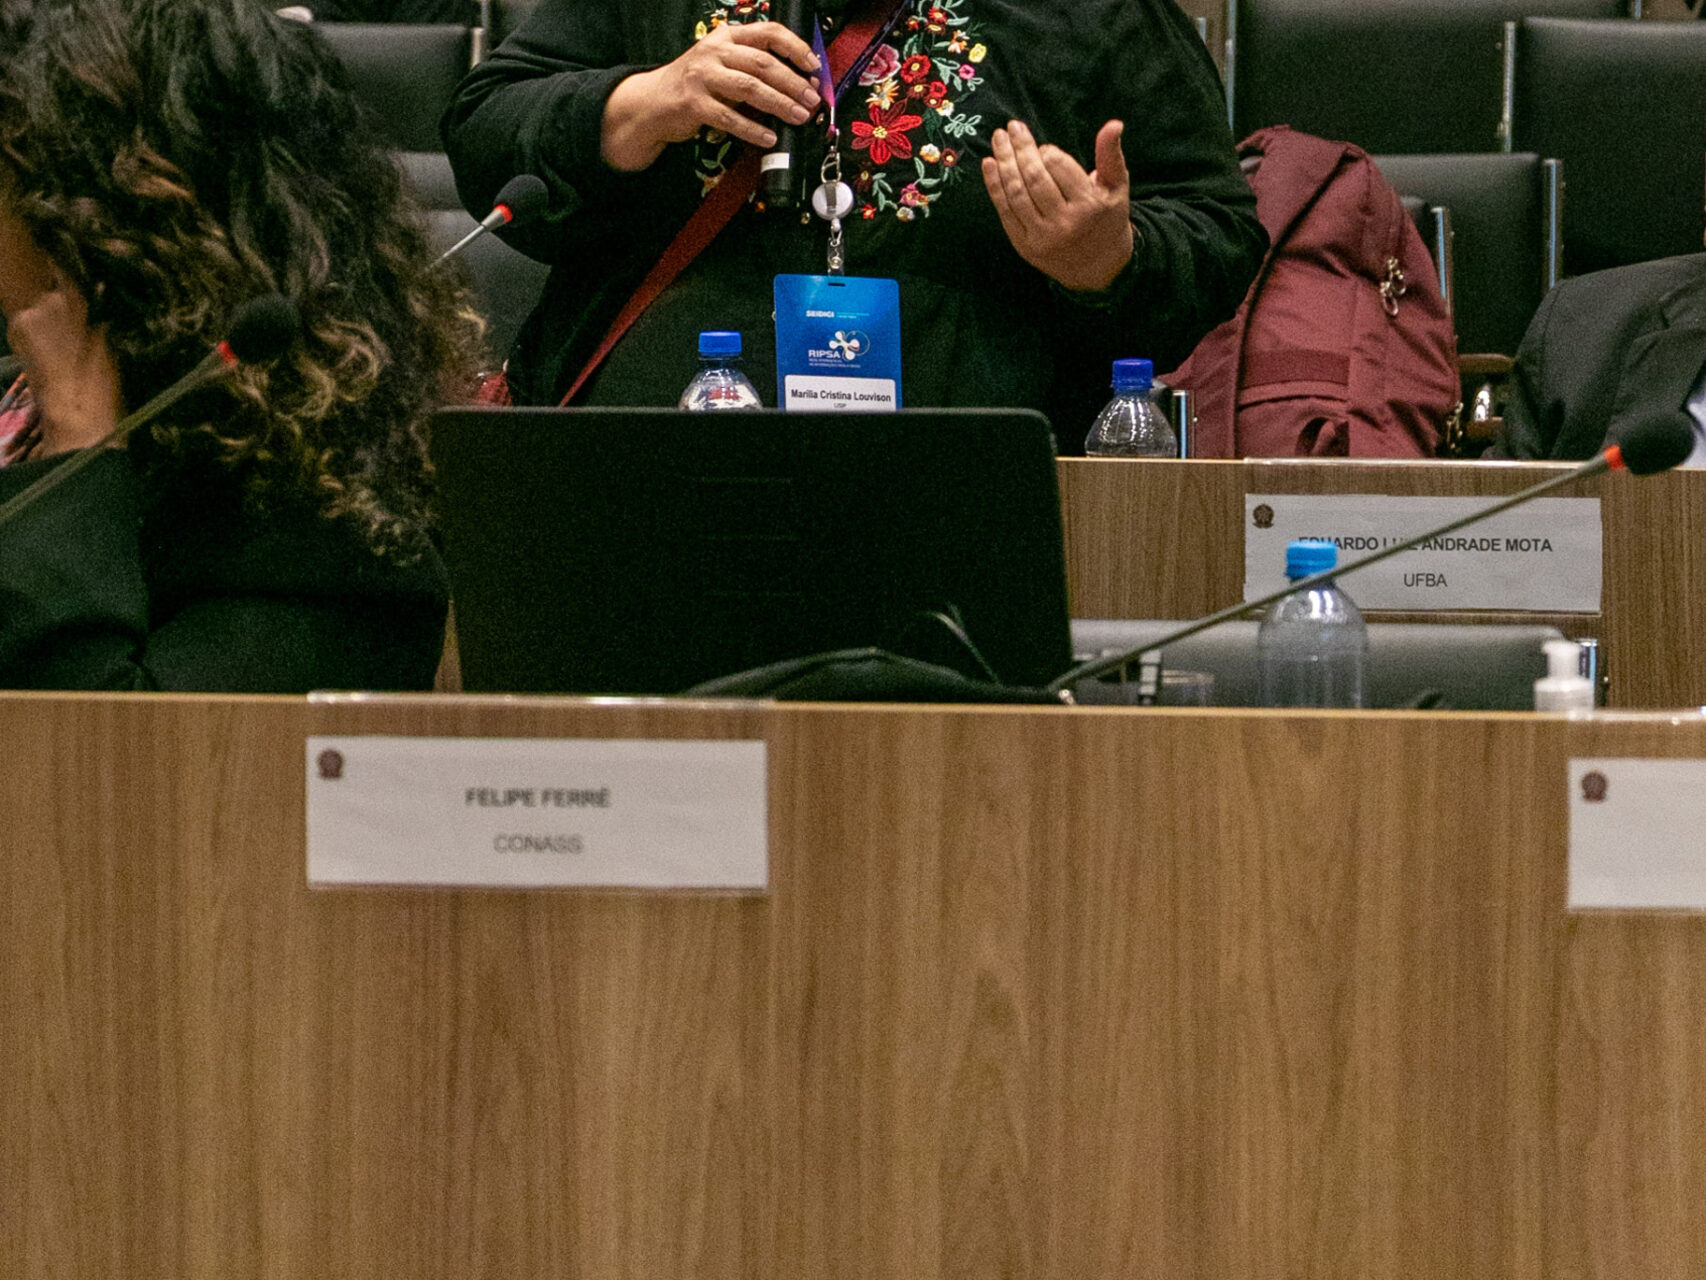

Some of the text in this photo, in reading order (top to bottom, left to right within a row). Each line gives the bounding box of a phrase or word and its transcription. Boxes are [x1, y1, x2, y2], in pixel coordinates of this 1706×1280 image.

[808, 349, 841, 359] RIPSA
[820, 390, 852, 400] Cristina
[853, 391, 891, 402] Louvison
[1299, 536, 1379, 551] ARDO
[1421, 537, 1502, 552] ANDRADE
[1505, 538, 1553, 552] MOTA
[1403, 573, 1447, 588] UFBA
[465, 788, 535, 807] FELIPE
[494, 835, 584, 853] CONASS
